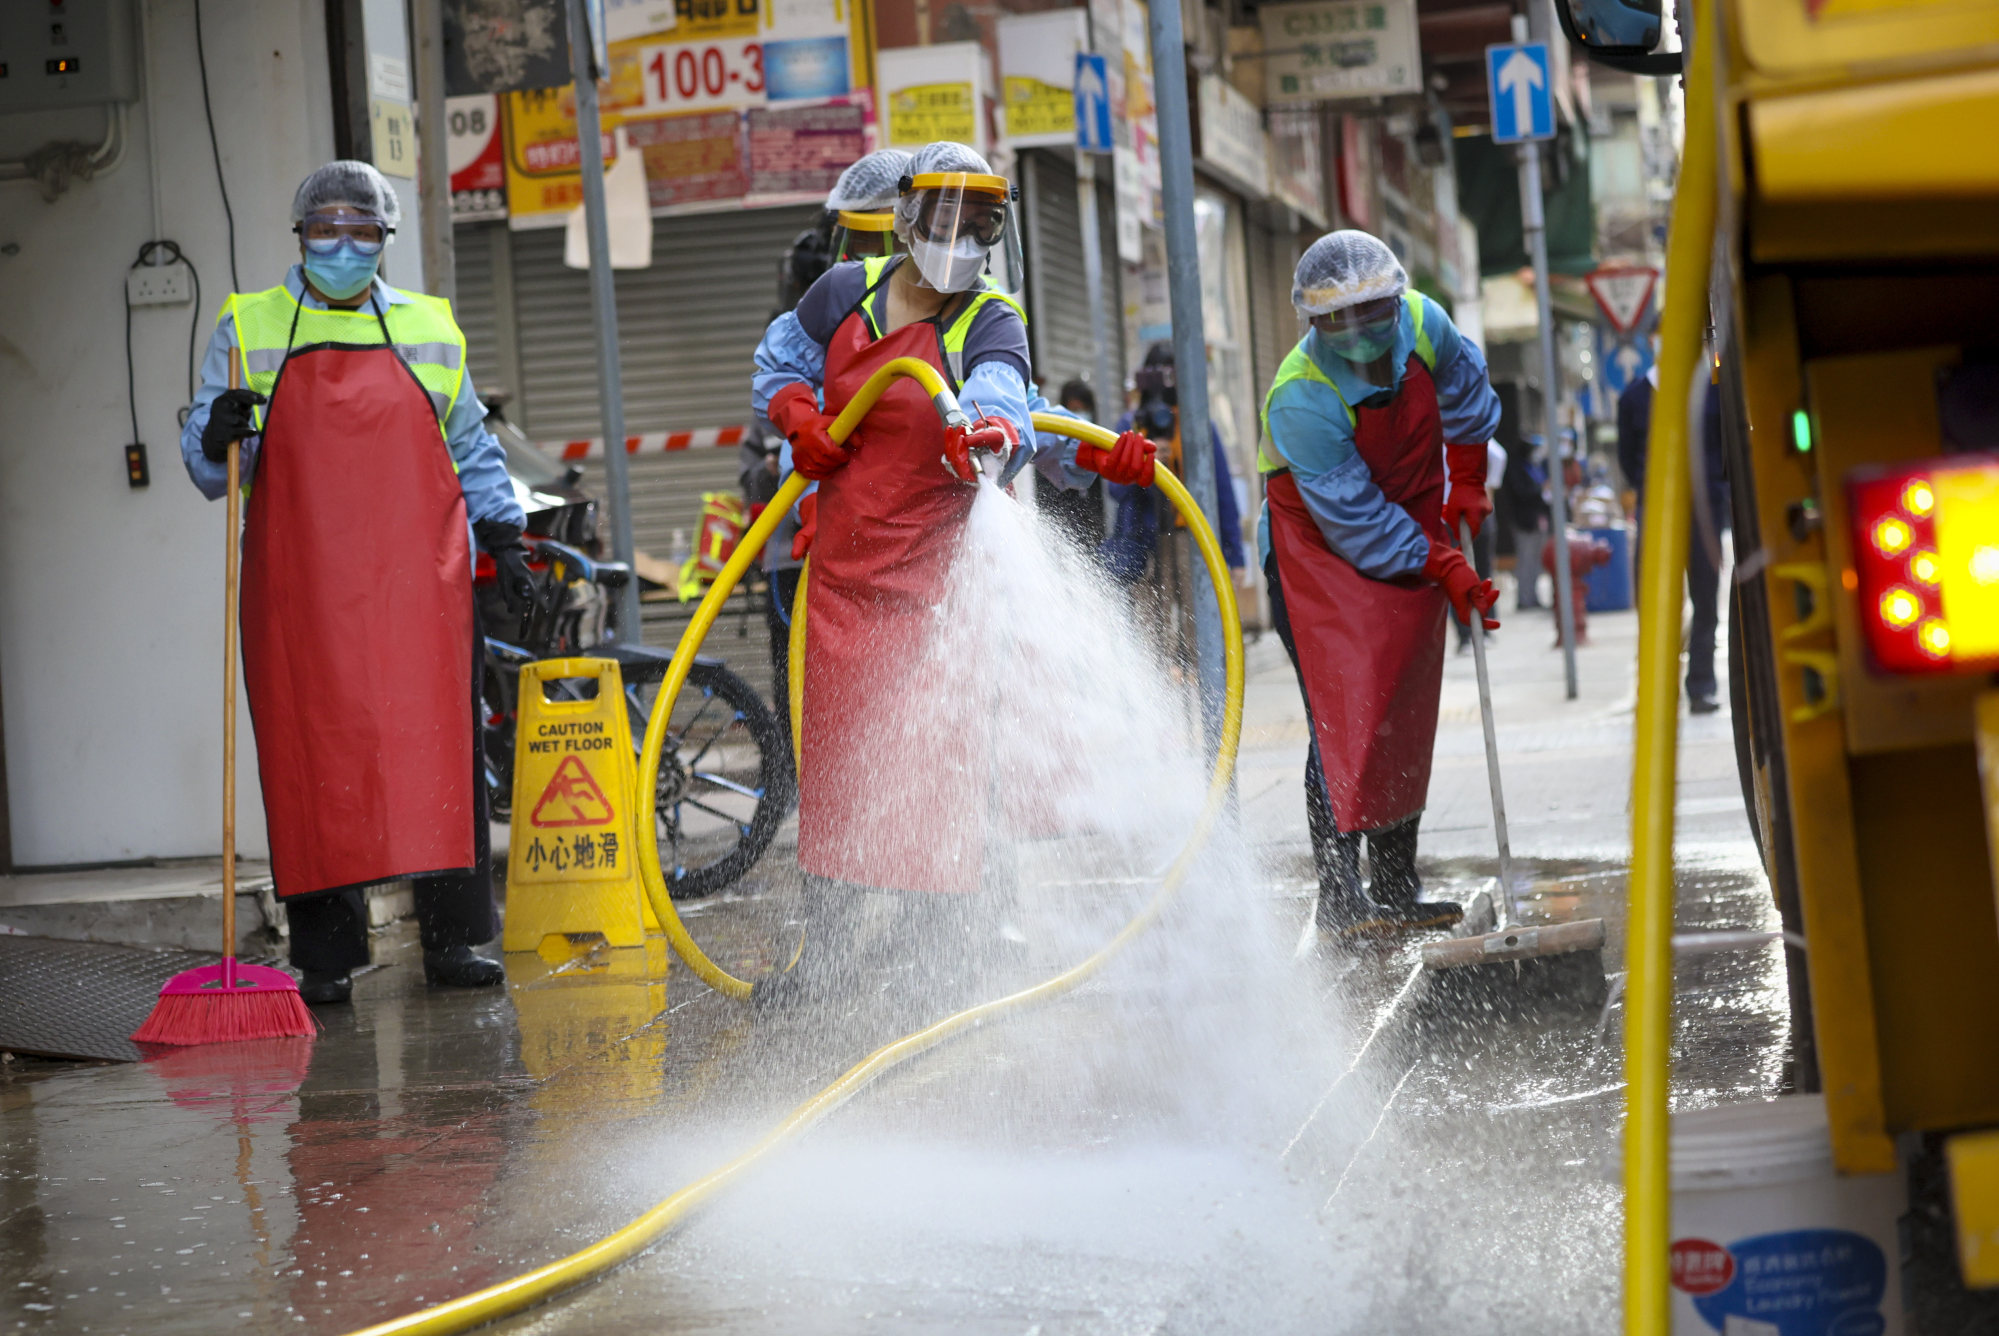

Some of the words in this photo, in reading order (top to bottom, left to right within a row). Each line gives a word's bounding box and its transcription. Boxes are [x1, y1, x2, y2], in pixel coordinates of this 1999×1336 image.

[538, 722, 604, 737] CAUTION
[528, 739, 560, 753] WET
[565, 737, 613, 751] FLOOR
[526, 832, 619, 872] 小心地滑
[1746, 1294, 1816, 1313] Laundry
